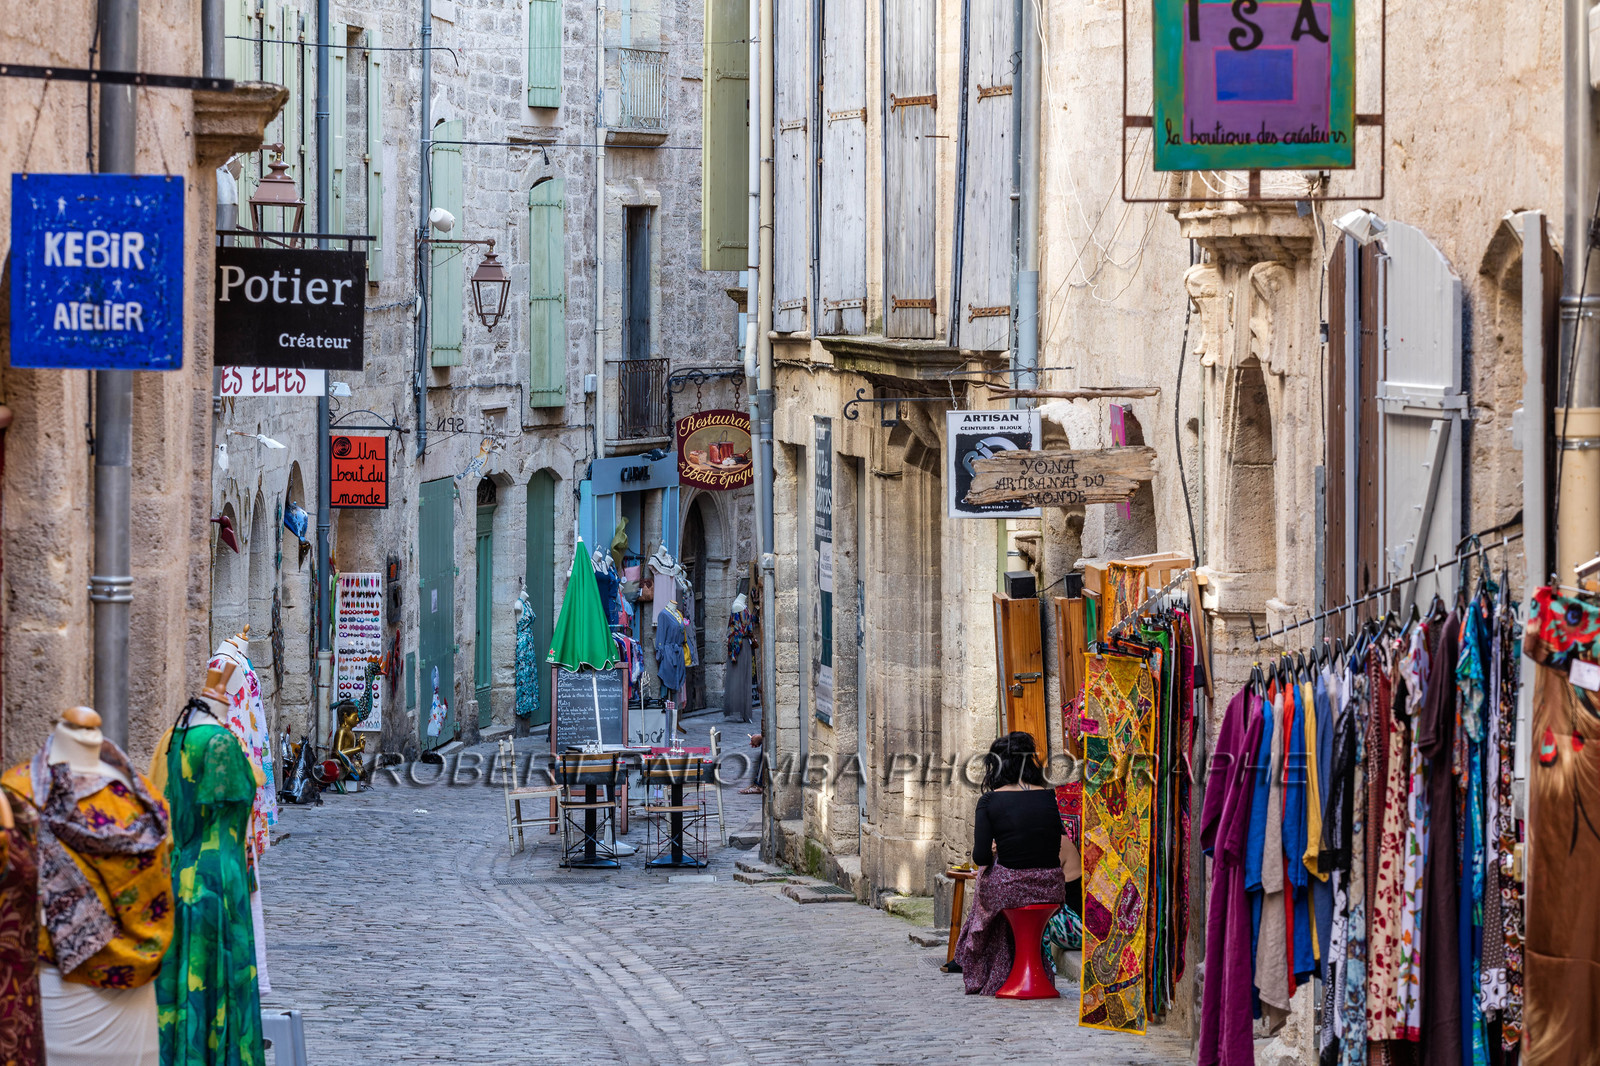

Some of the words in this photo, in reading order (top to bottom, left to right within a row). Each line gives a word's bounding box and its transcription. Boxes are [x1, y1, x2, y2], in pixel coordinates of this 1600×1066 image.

[1165, 118, 1181, 145] la
[1257, 122, 1278, 145] des
[219, 265, 352, 306] Potier
[279, 333, 351, 350] Créateur
[678, 413, 750, 437] Restauran
[963, 414, 1019, 423] ARTISAN
[1020, 458, 1080, 475] YONA
[1083, 474, 1105, 488] DU
[334, 487, 384, 505] monde
[1026, 490, 1087, 505] MONDE
